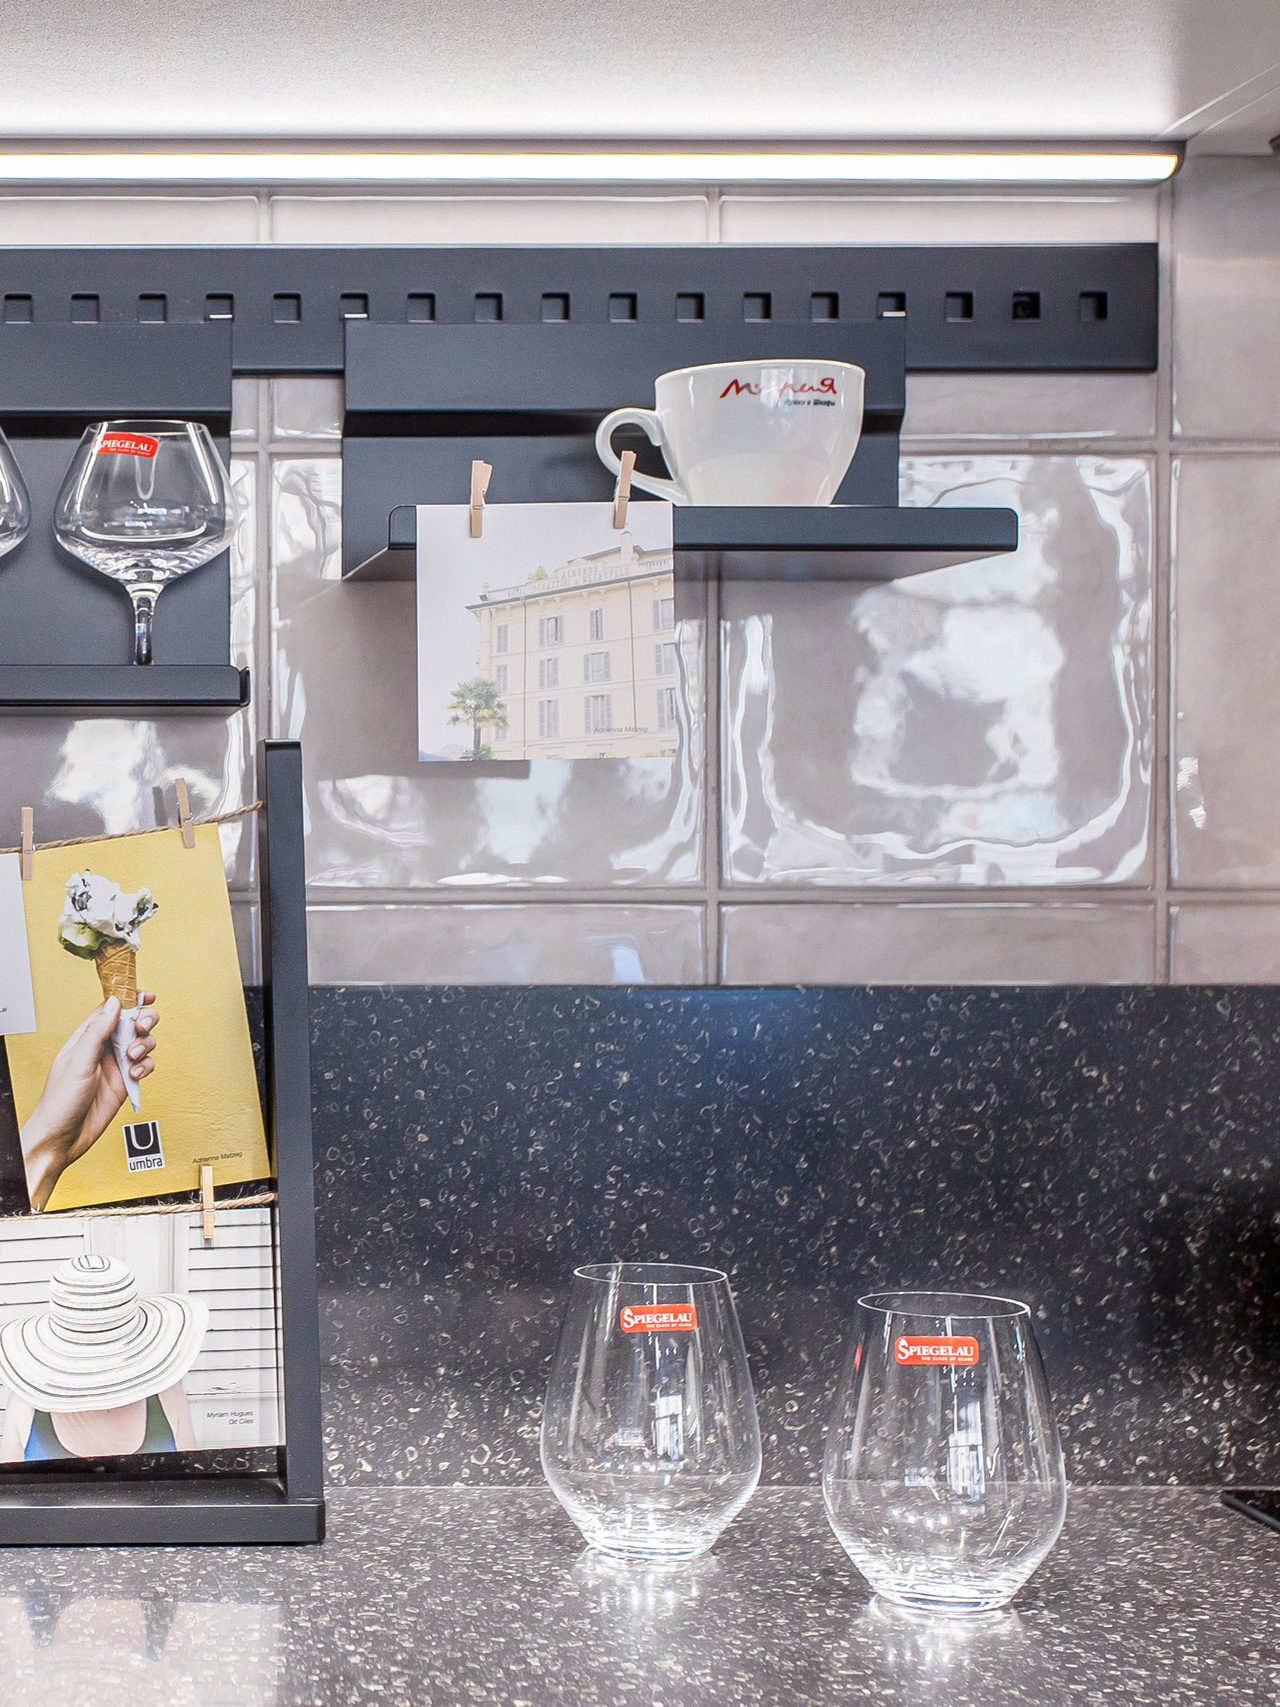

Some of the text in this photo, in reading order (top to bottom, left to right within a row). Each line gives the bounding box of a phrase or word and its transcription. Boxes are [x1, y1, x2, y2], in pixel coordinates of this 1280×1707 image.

[129, 1157, 163, 1171] umbra
[623, 1309, 692, 1328] SPIEGELAU
[898, 1339, 974, 1359] SPIEGELAU
